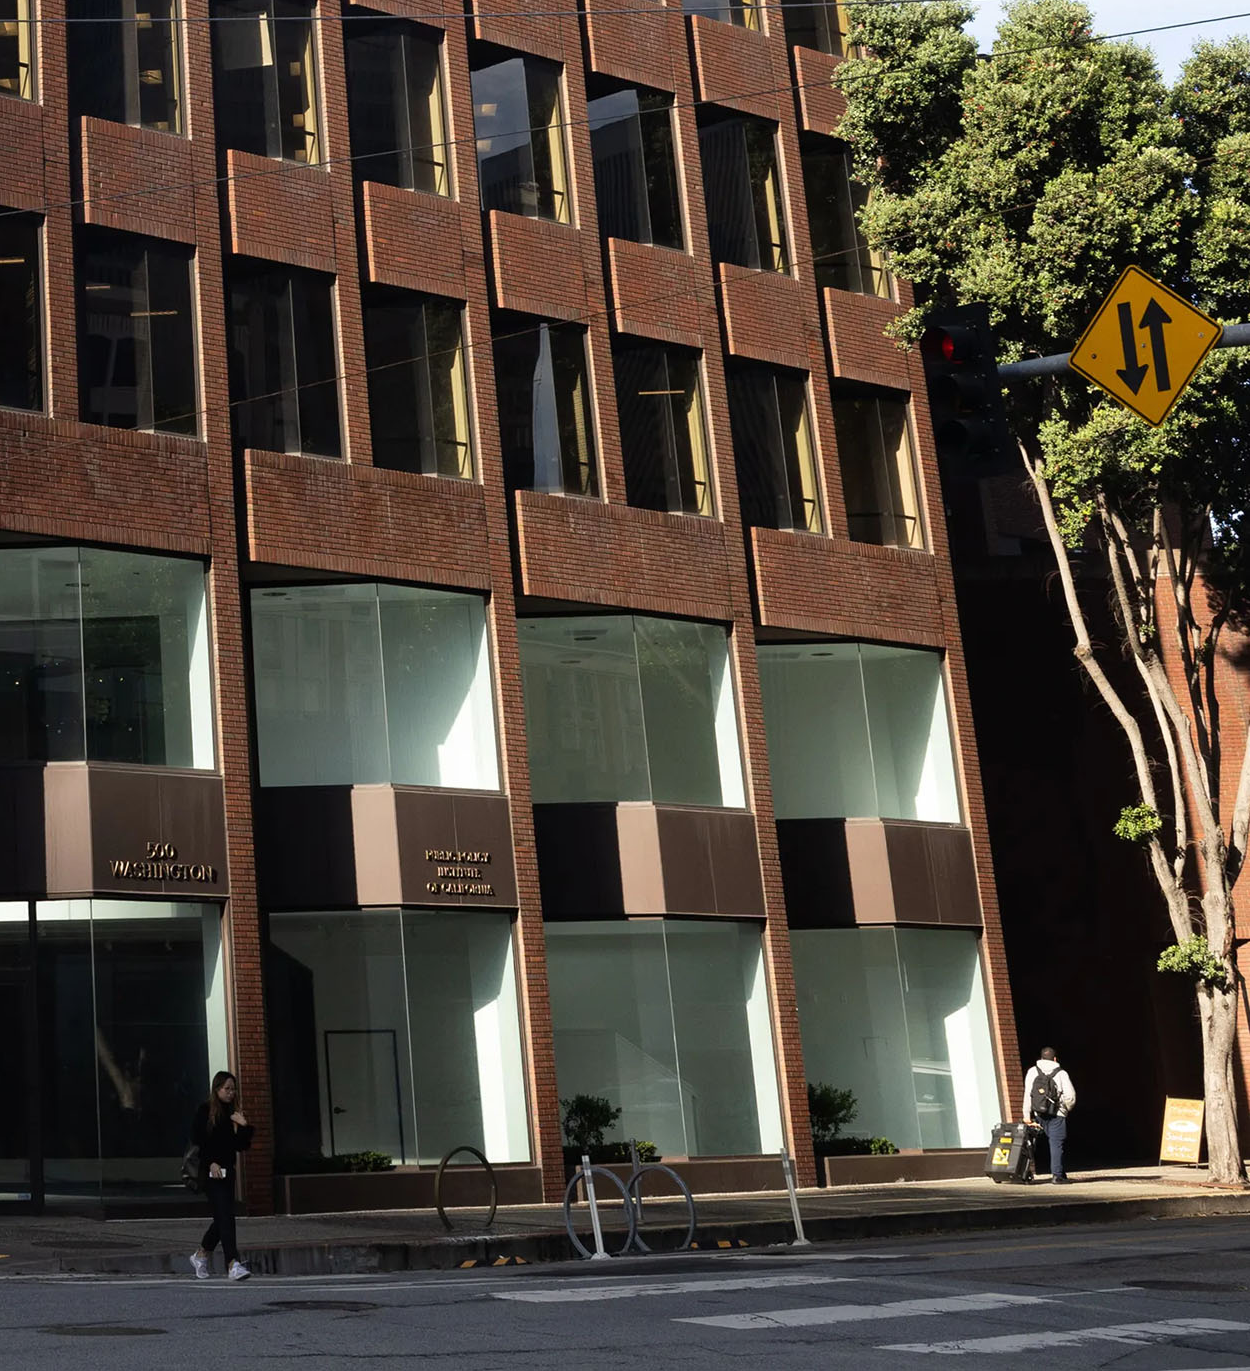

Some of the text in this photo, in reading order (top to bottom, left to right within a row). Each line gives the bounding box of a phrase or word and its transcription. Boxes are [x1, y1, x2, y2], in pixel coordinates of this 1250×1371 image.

[146, 841, 175, 859] 500
[458, 851, 490, 862] POLICY
[110, 860, 213, 881] WASHINGTON
